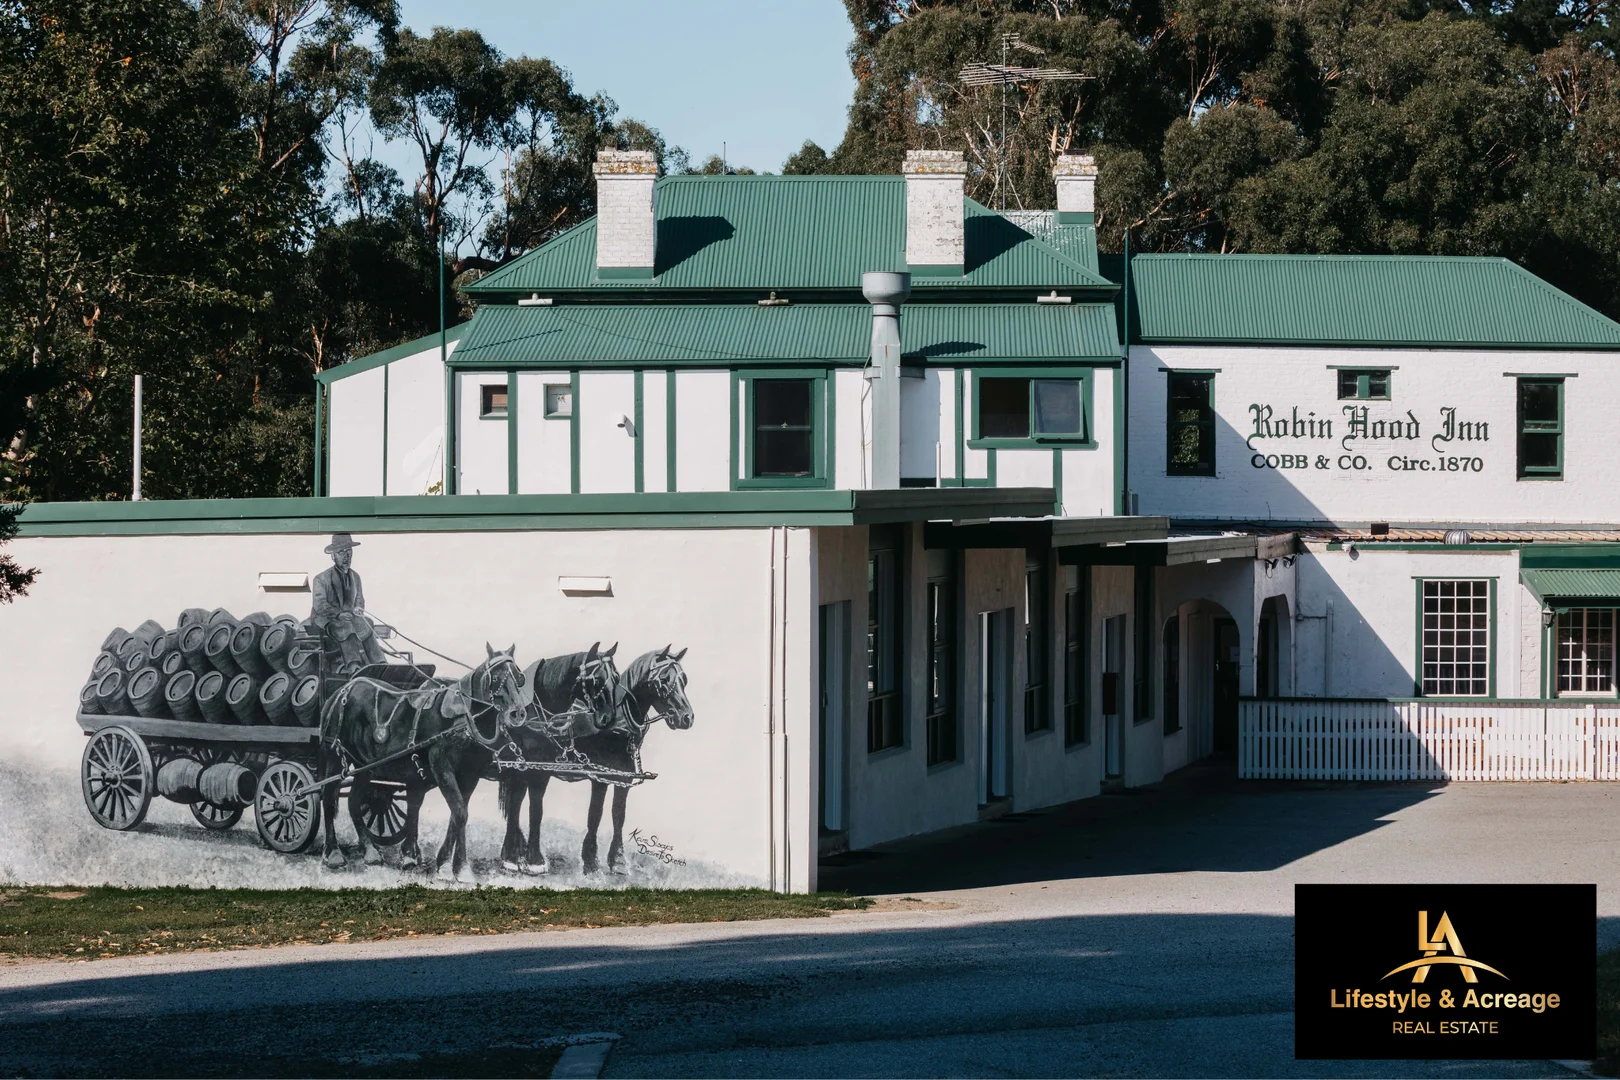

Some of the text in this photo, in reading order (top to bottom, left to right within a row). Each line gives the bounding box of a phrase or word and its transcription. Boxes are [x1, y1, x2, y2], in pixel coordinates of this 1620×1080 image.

[1247, 403, 1490, 453] Robin Hood Inn
[1251, 454, 1309, 469] COBB
[1315, 455, 1330, 470] &
[1338, 456, 1372, 470] CO.
